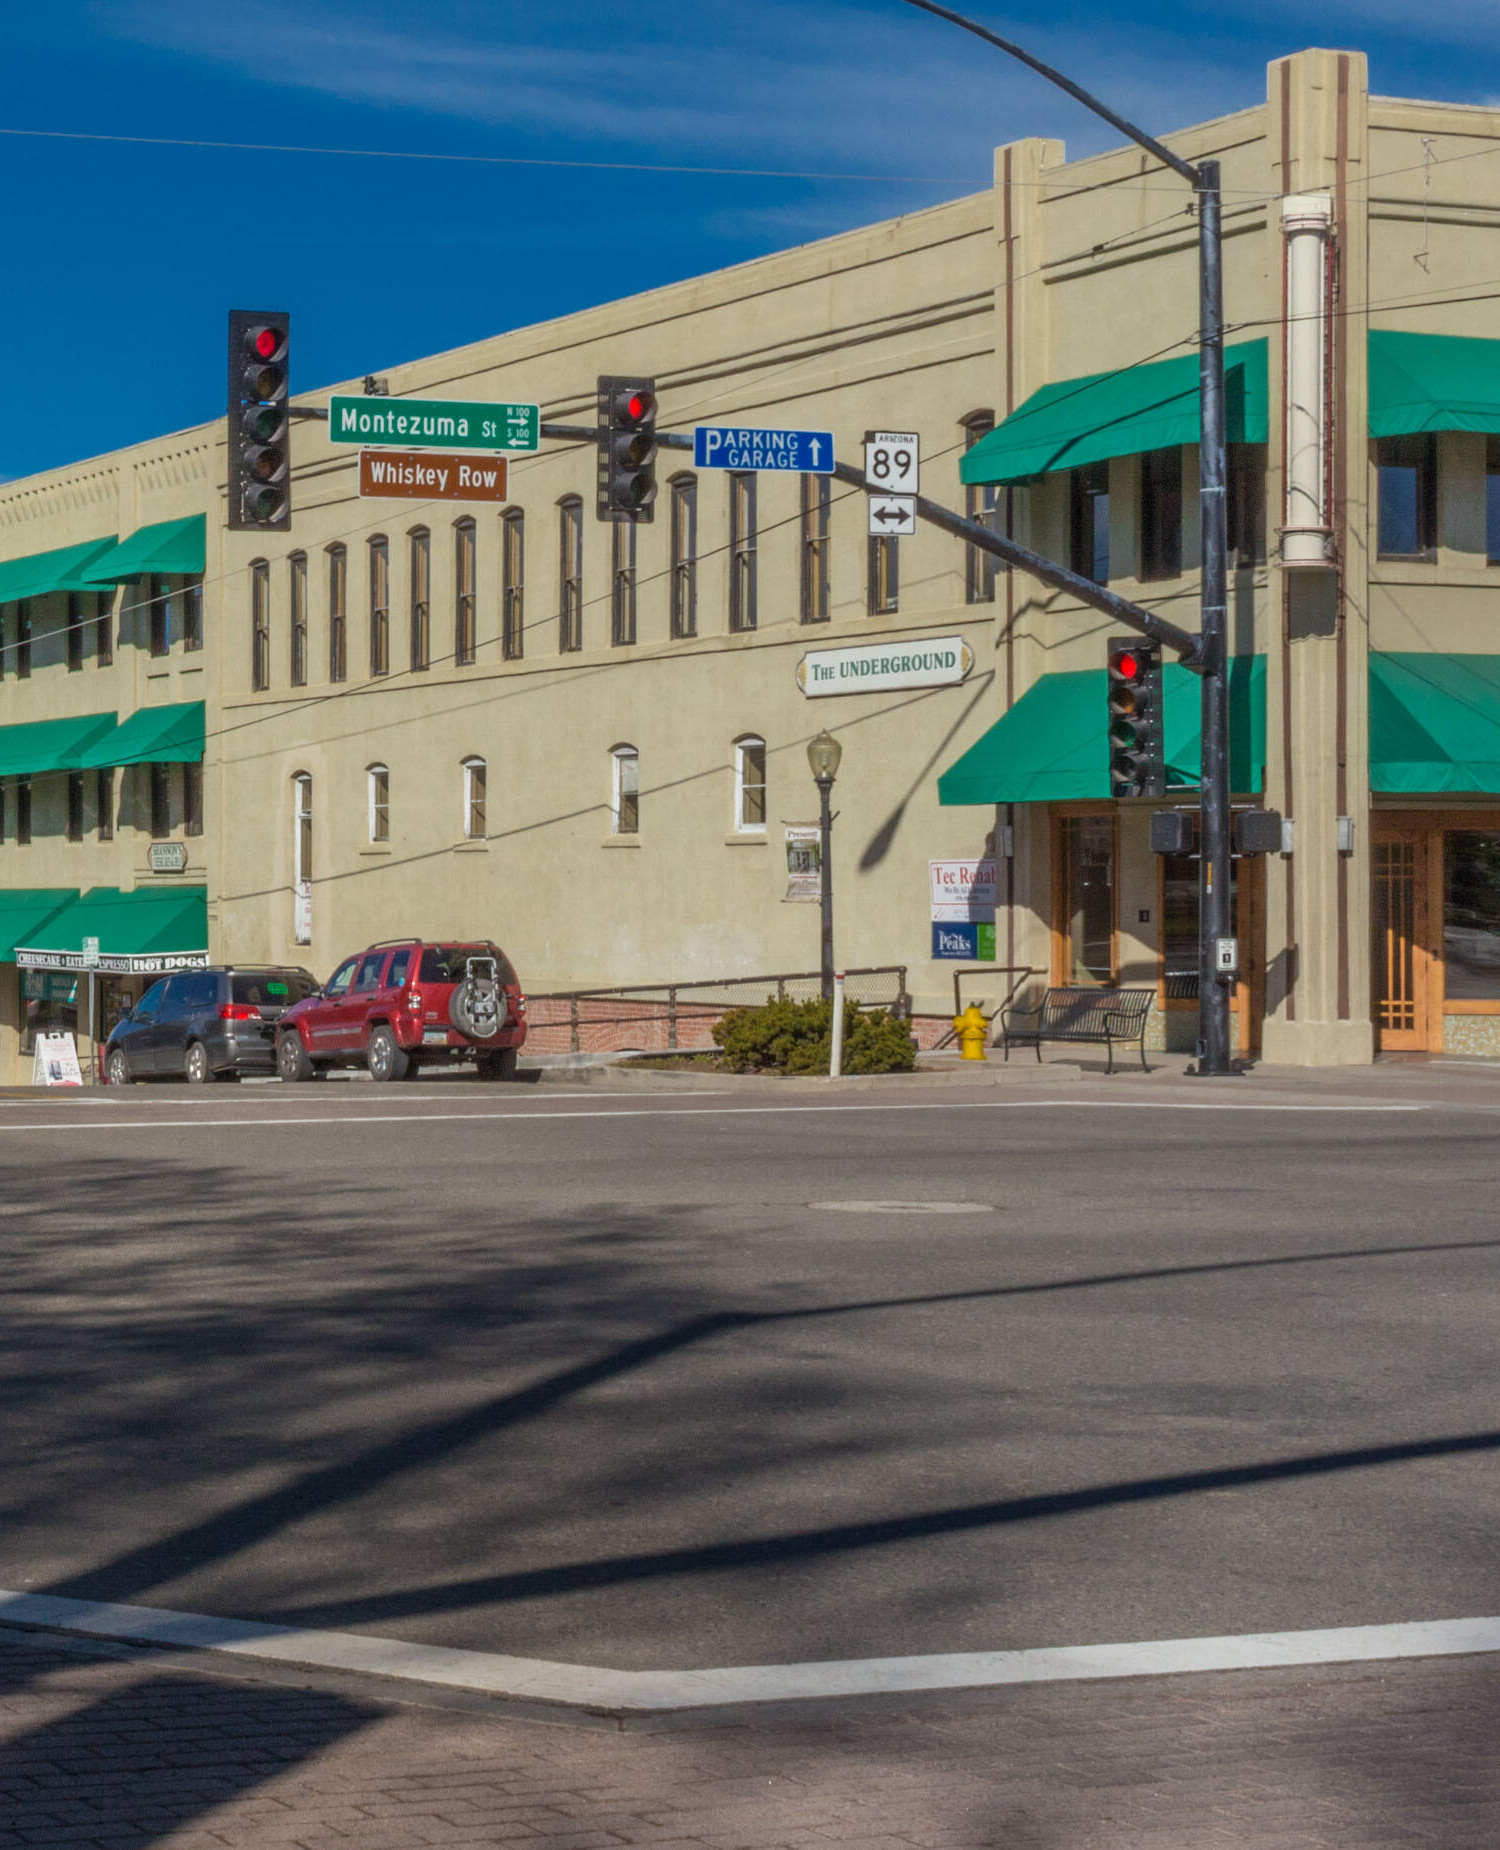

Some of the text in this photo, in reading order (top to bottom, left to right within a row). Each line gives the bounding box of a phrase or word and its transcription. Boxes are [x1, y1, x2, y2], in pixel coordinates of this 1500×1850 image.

[506, 407, 530, 417] N 100
[341, 407, 497, 438] Montezuma St
[506, 428, 530, 439] S 100
[878, 434, 915, 444] ARIZONA
[705, 429, 799, 465] PARKING
[728, 448, 799, 469] GARAGE
[872, 448, 912, 479] 89
[370, 461, 498, 492] Whiskey Row
[839, 650, 957, 679] UNDERGROUND
[933, 866, 956, 885] Tec
[938, 933, 972, 951] Peaks
[18, 952, 61, 966] CHEESECAKE
[133, 957, 163, 971] HOT
